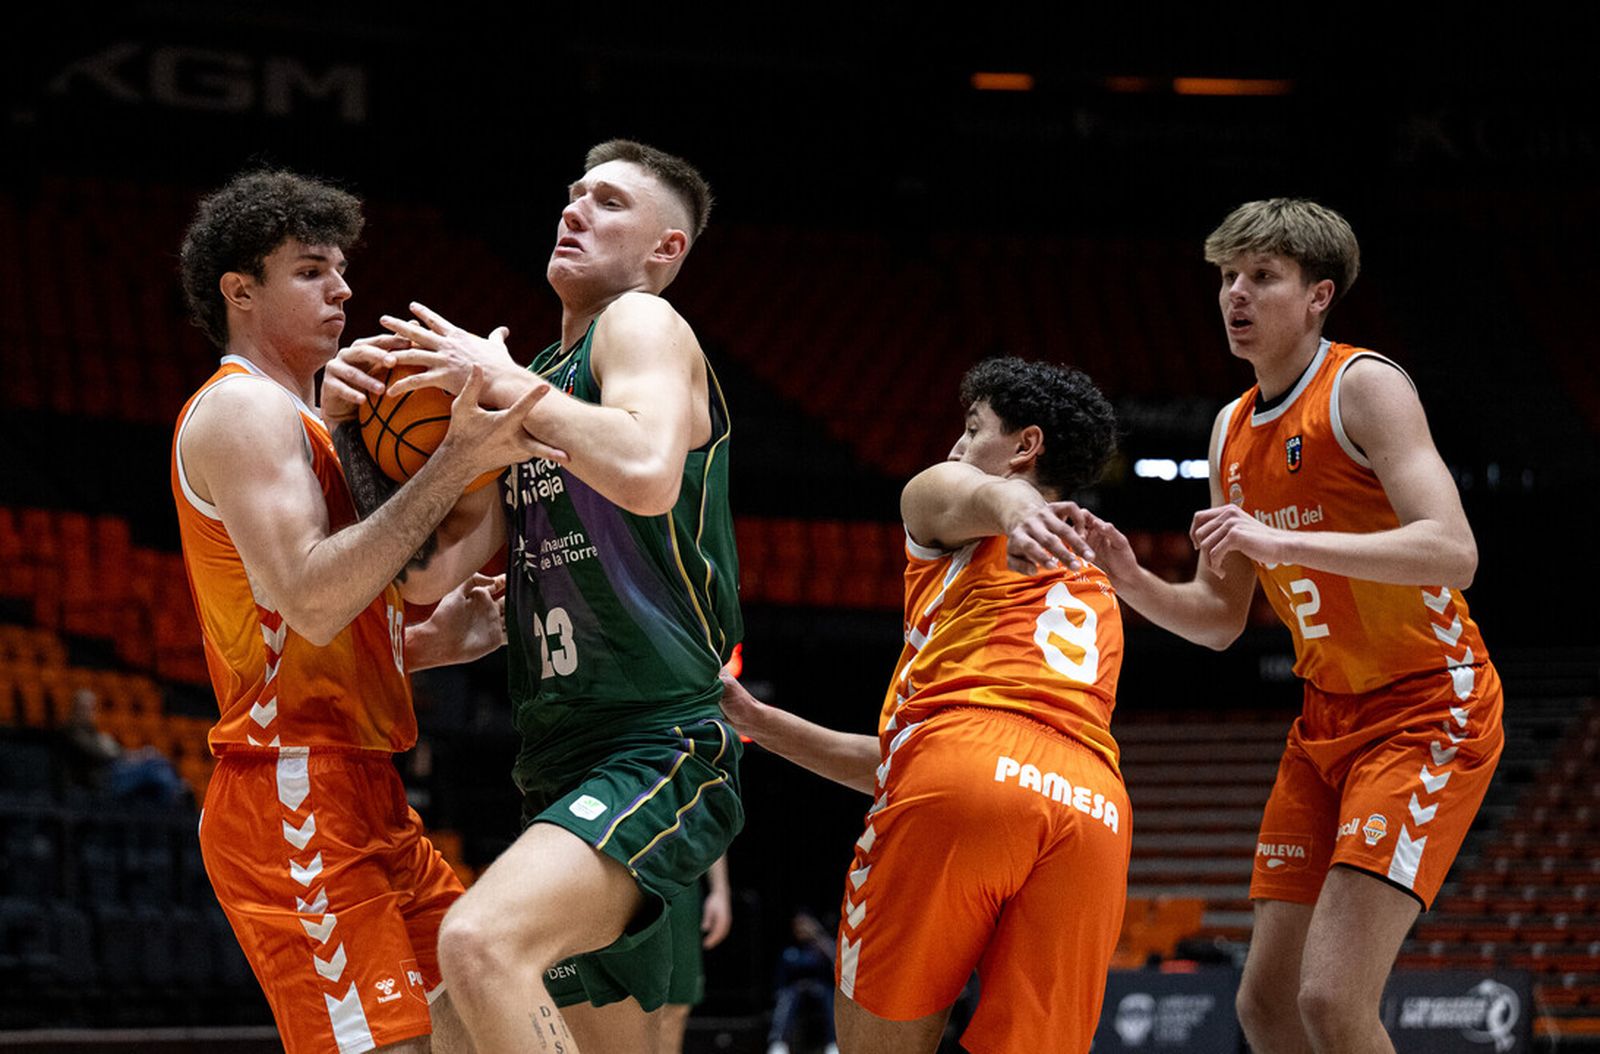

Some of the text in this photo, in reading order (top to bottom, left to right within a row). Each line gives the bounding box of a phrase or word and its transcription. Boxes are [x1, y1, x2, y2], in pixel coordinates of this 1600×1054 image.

[1301, 504, 1324, 525] del
[552, 552, 563, 566] la
[561, 545, 598, 563] Torre
[1033, 581, 1100, 686] 8
[994, 756, 1119, 835] PAMESA
[1256, 842, 1305, 858] PULEVA
